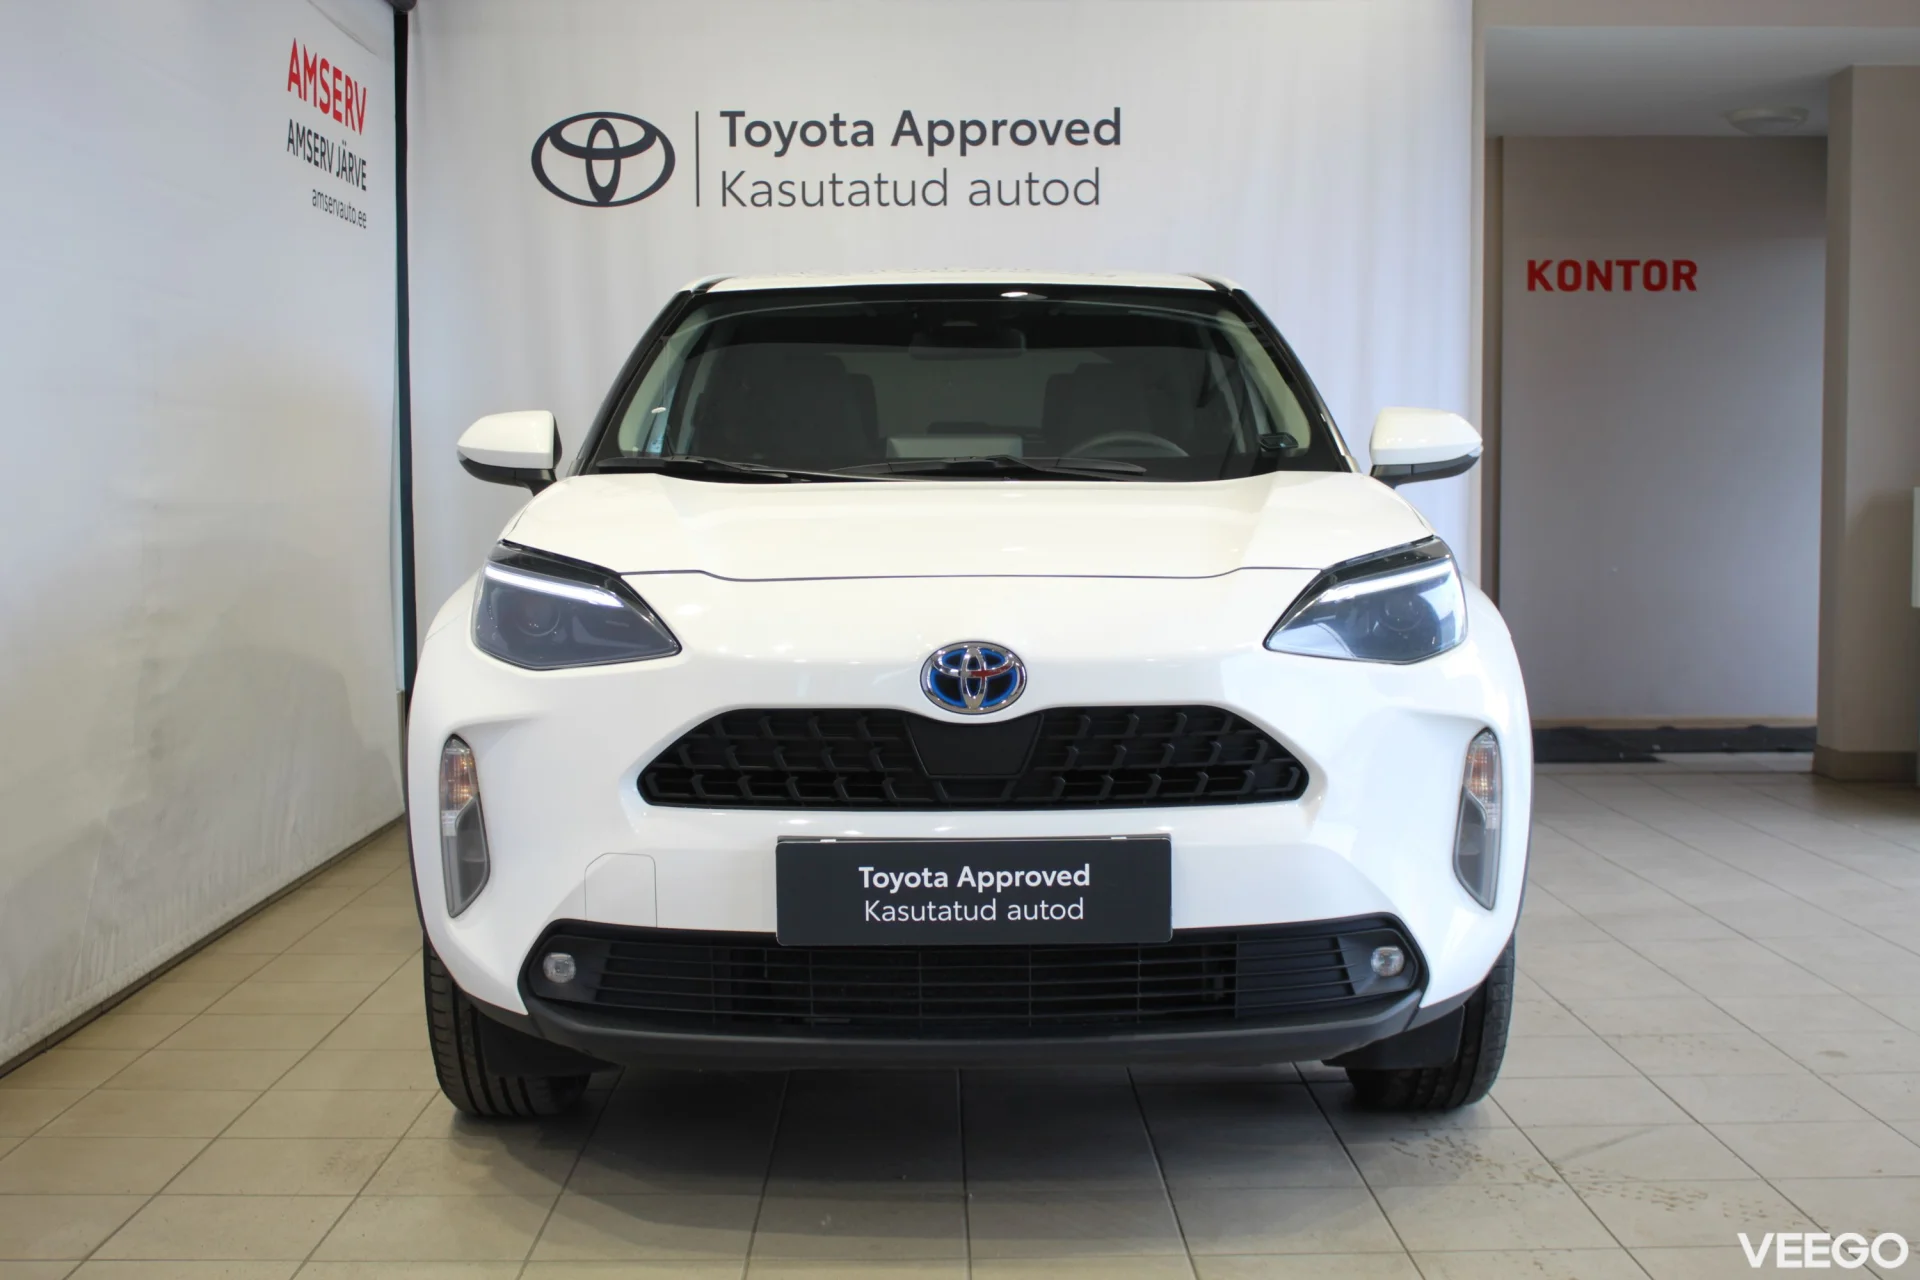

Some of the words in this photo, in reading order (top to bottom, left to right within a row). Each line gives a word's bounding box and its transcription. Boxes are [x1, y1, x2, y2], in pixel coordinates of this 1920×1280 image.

[287, 37, 366, 135] AMSERV
[719, 110, 875, 157] Toyota
[890, 107, 1121, 157] Approved
[287, 119, 334, 174] AMSERV
[335, 140, 366, 191] JÄRVE
[720, 167, 947, 207] Kasutatud
[968, 167, 1100, 207] autod
[312, 188, 367, 229] amservauto.ee
[1527, 259, 1698, 292] KONTOR
[858, 867, 949, 893] Toyota
[957, 863, 1090, 893] Approved
[864, 899, 997, 922] Kasutatud
[1007, 897, 1084, 920] autod
